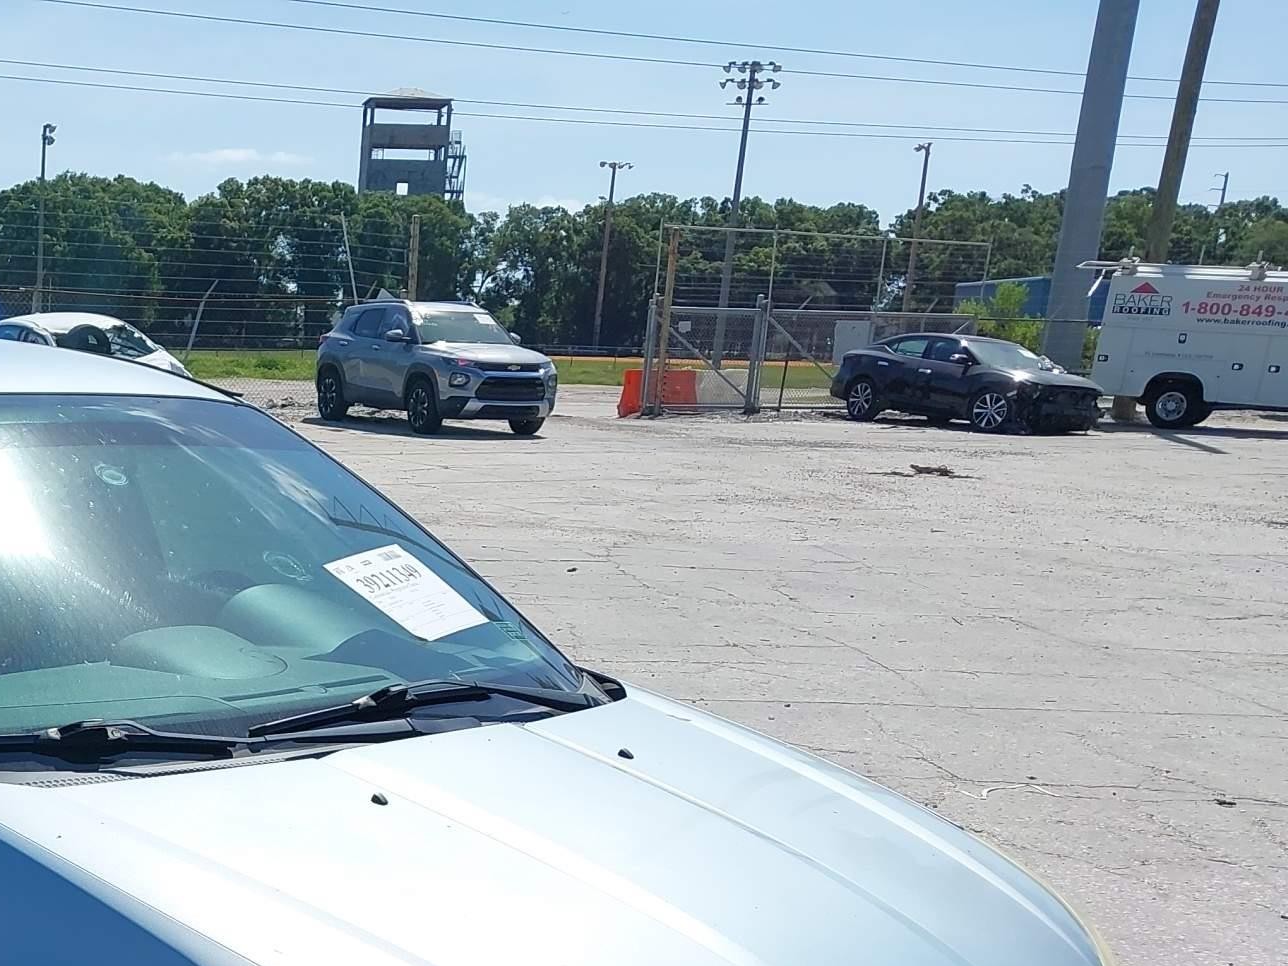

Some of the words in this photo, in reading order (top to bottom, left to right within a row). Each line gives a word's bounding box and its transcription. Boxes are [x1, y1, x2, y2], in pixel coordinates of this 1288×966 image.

[1253, 285, 1284, 293] HOUR
[1114, 293, 1173, 307] BAKER
[1206, 291, 1261, 302] Emergency
[1112, 306, 1170, 315] ROOFING
[355, 563, 422, 594] 39211349
